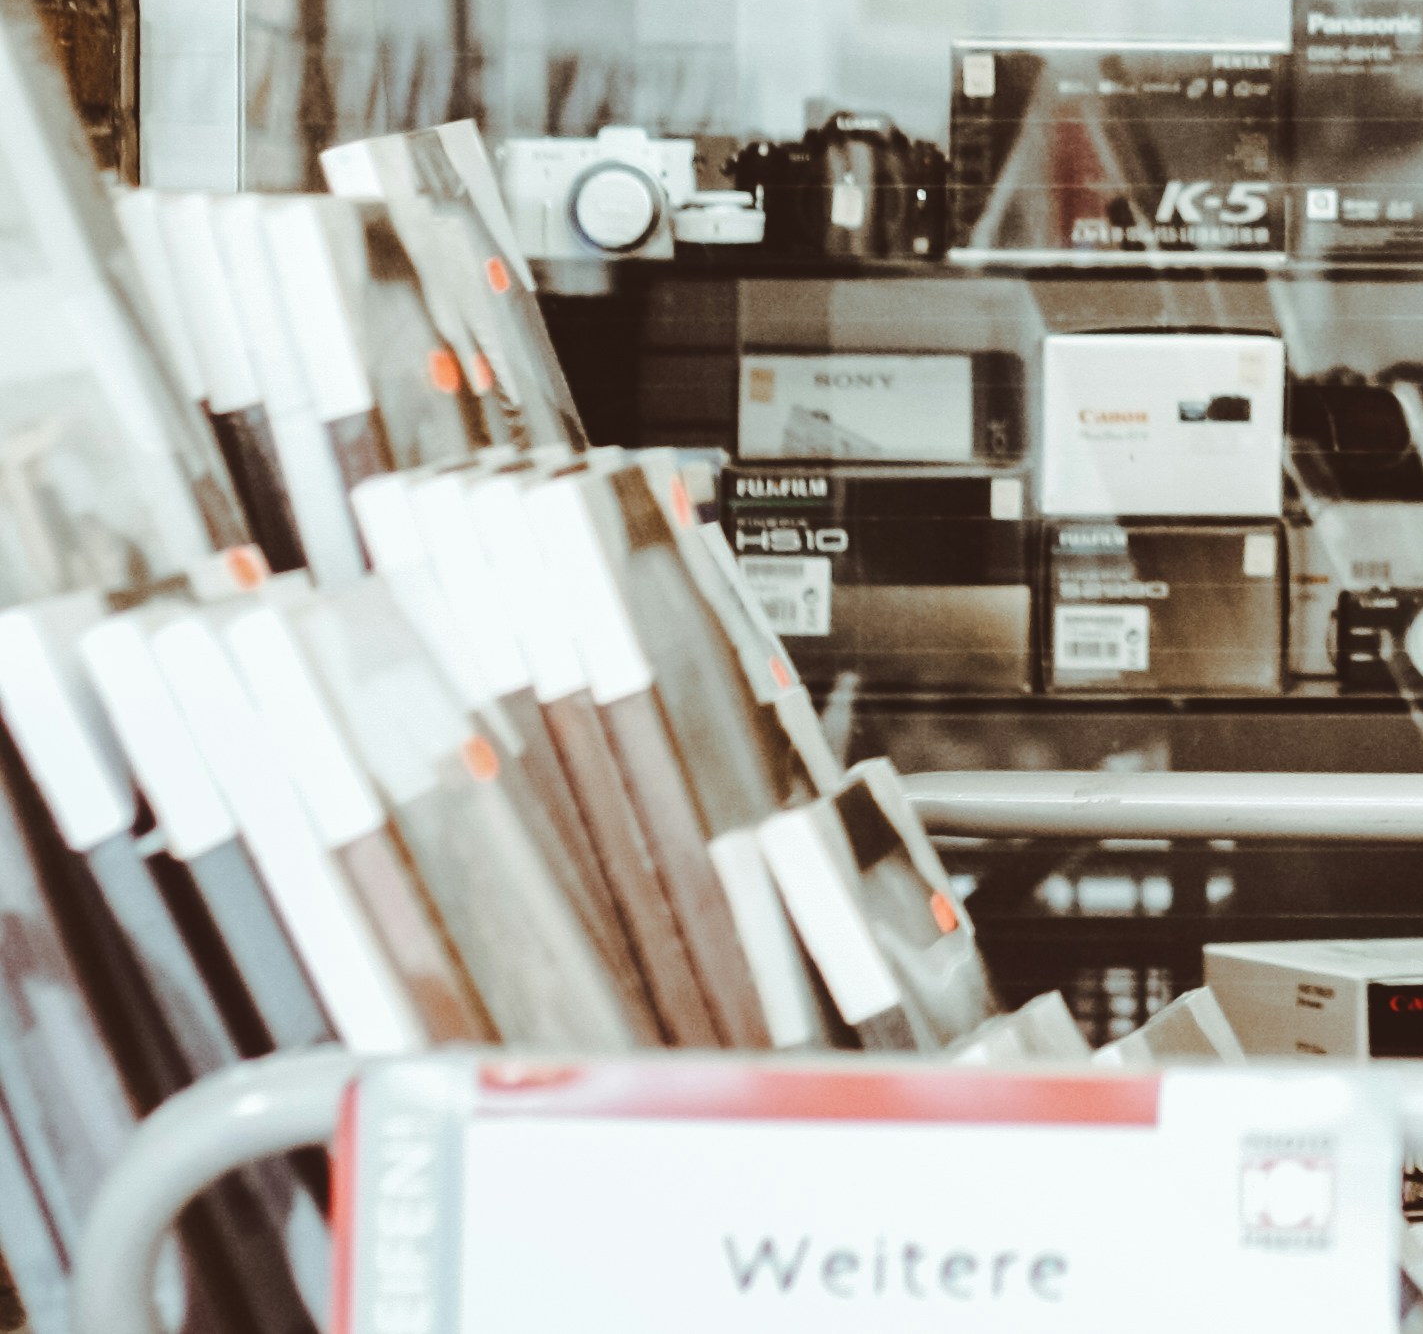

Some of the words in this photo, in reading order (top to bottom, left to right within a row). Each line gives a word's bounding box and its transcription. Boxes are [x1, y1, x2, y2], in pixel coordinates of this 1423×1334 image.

[1154, 179, 1272, 224] K-5
[812, 374, 895, 389] SONY
[1078, 408, 1150, 425] Canon
[735, 477, 829, 498] FUJIFILM
[735, 527, 850, 553] HS10
[720, 1232, 1072, 1304] Weitere
